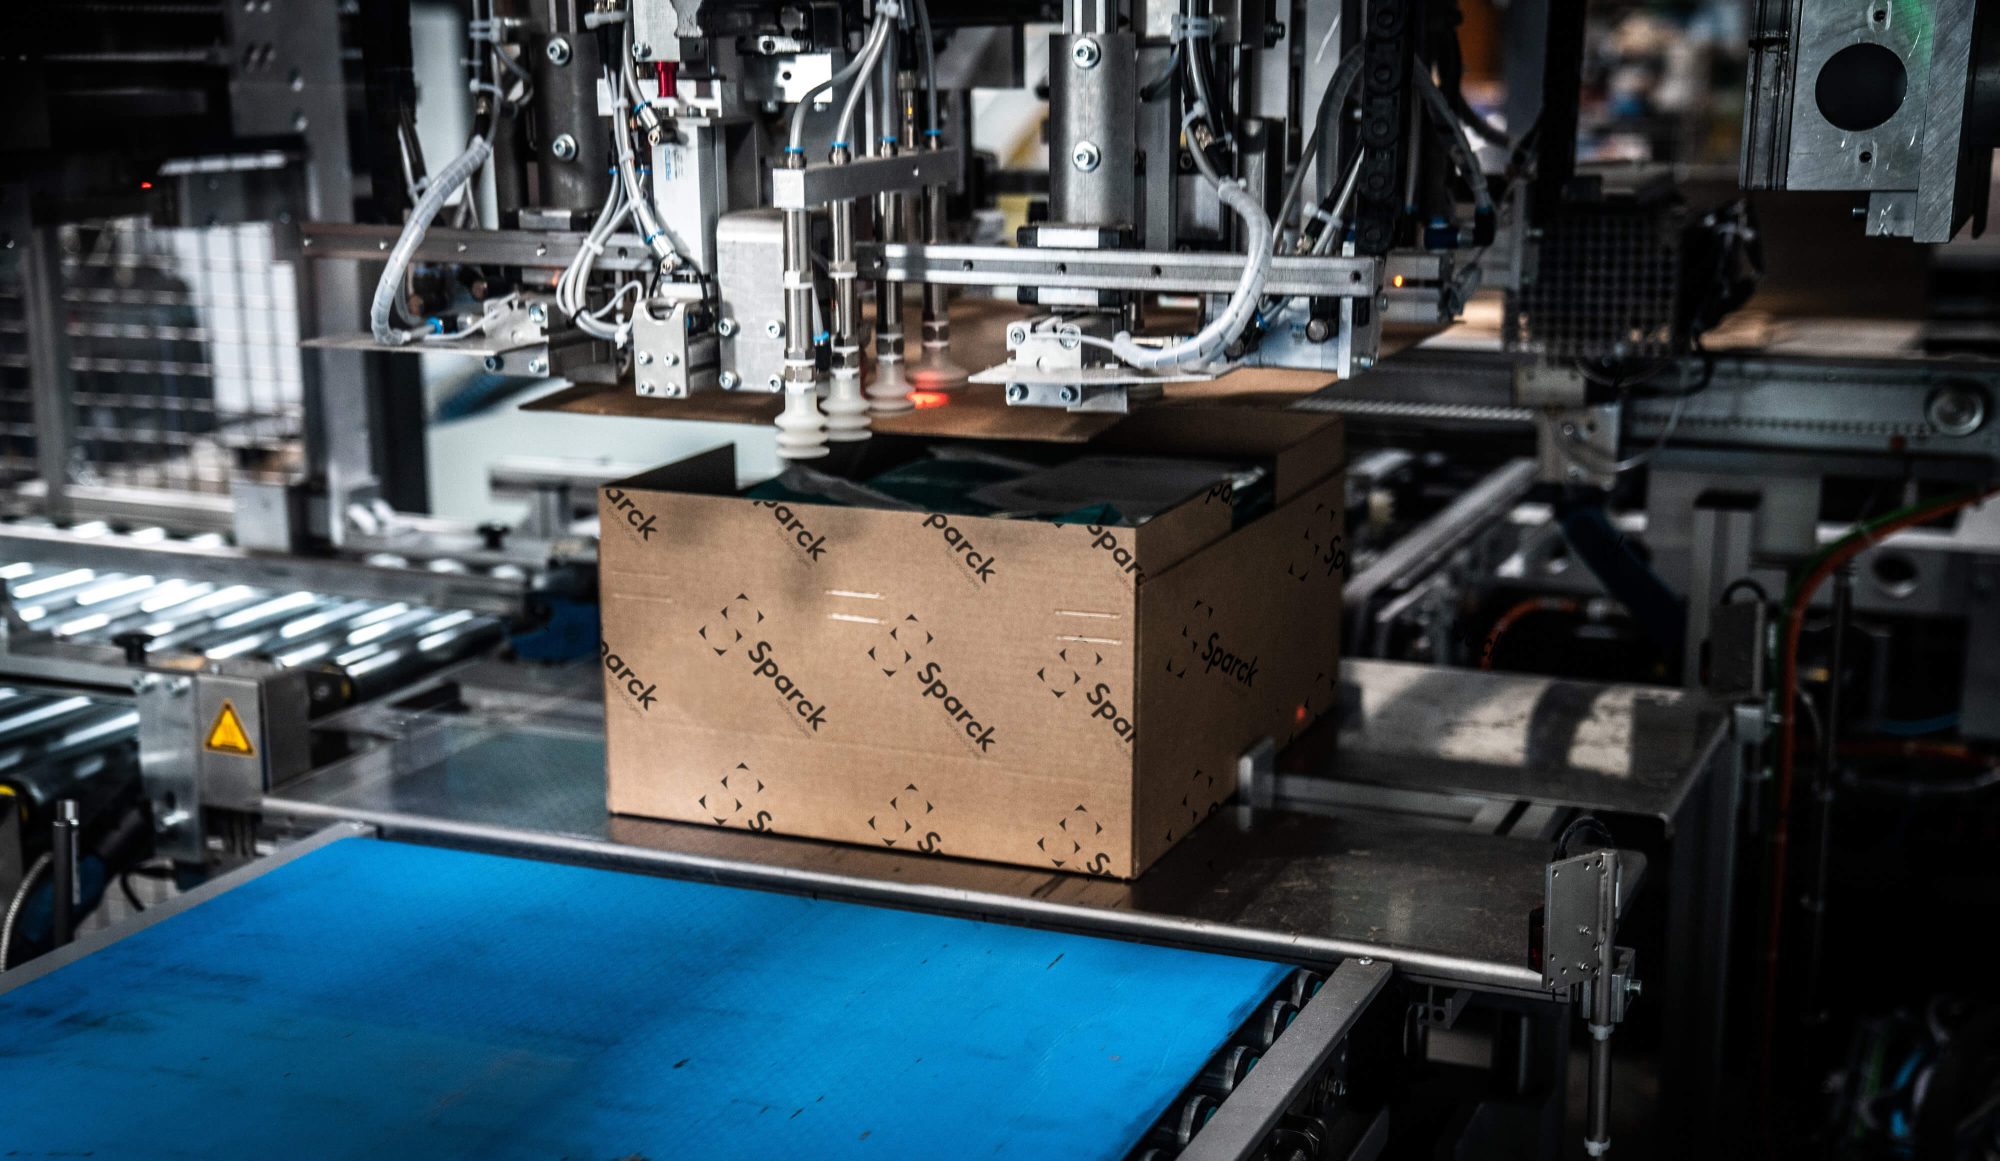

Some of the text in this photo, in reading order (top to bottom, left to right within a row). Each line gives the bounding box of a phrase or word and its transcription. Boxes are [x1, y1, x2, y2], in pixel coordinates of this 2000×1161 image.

[748, 640, 827, 732] Sparck
[1202, 632, 1259, 688] Sparck
[917, 662, 996, 752] Sparck
